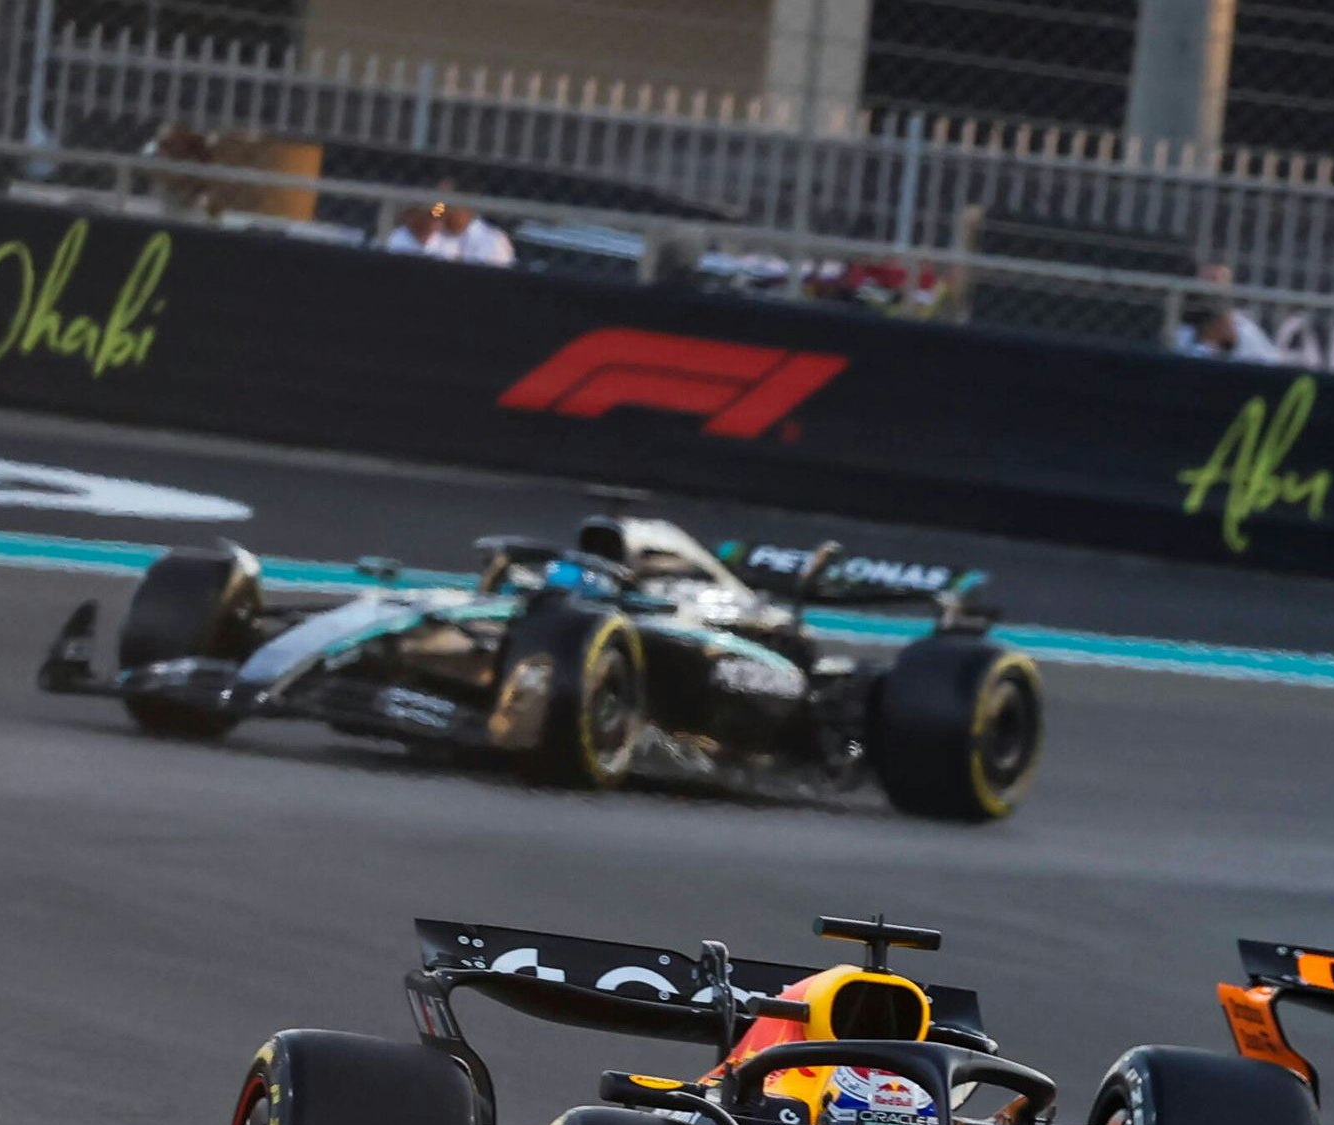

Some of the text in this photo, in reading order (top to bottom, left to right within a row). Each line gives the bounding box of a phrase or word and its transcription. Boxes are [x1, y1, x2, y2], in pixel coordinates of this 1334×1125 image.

[497, 328, 848, 439] F1
[1178, 375, 1332, 553] Abu
[747, 544, 951, 592] PEONAS
